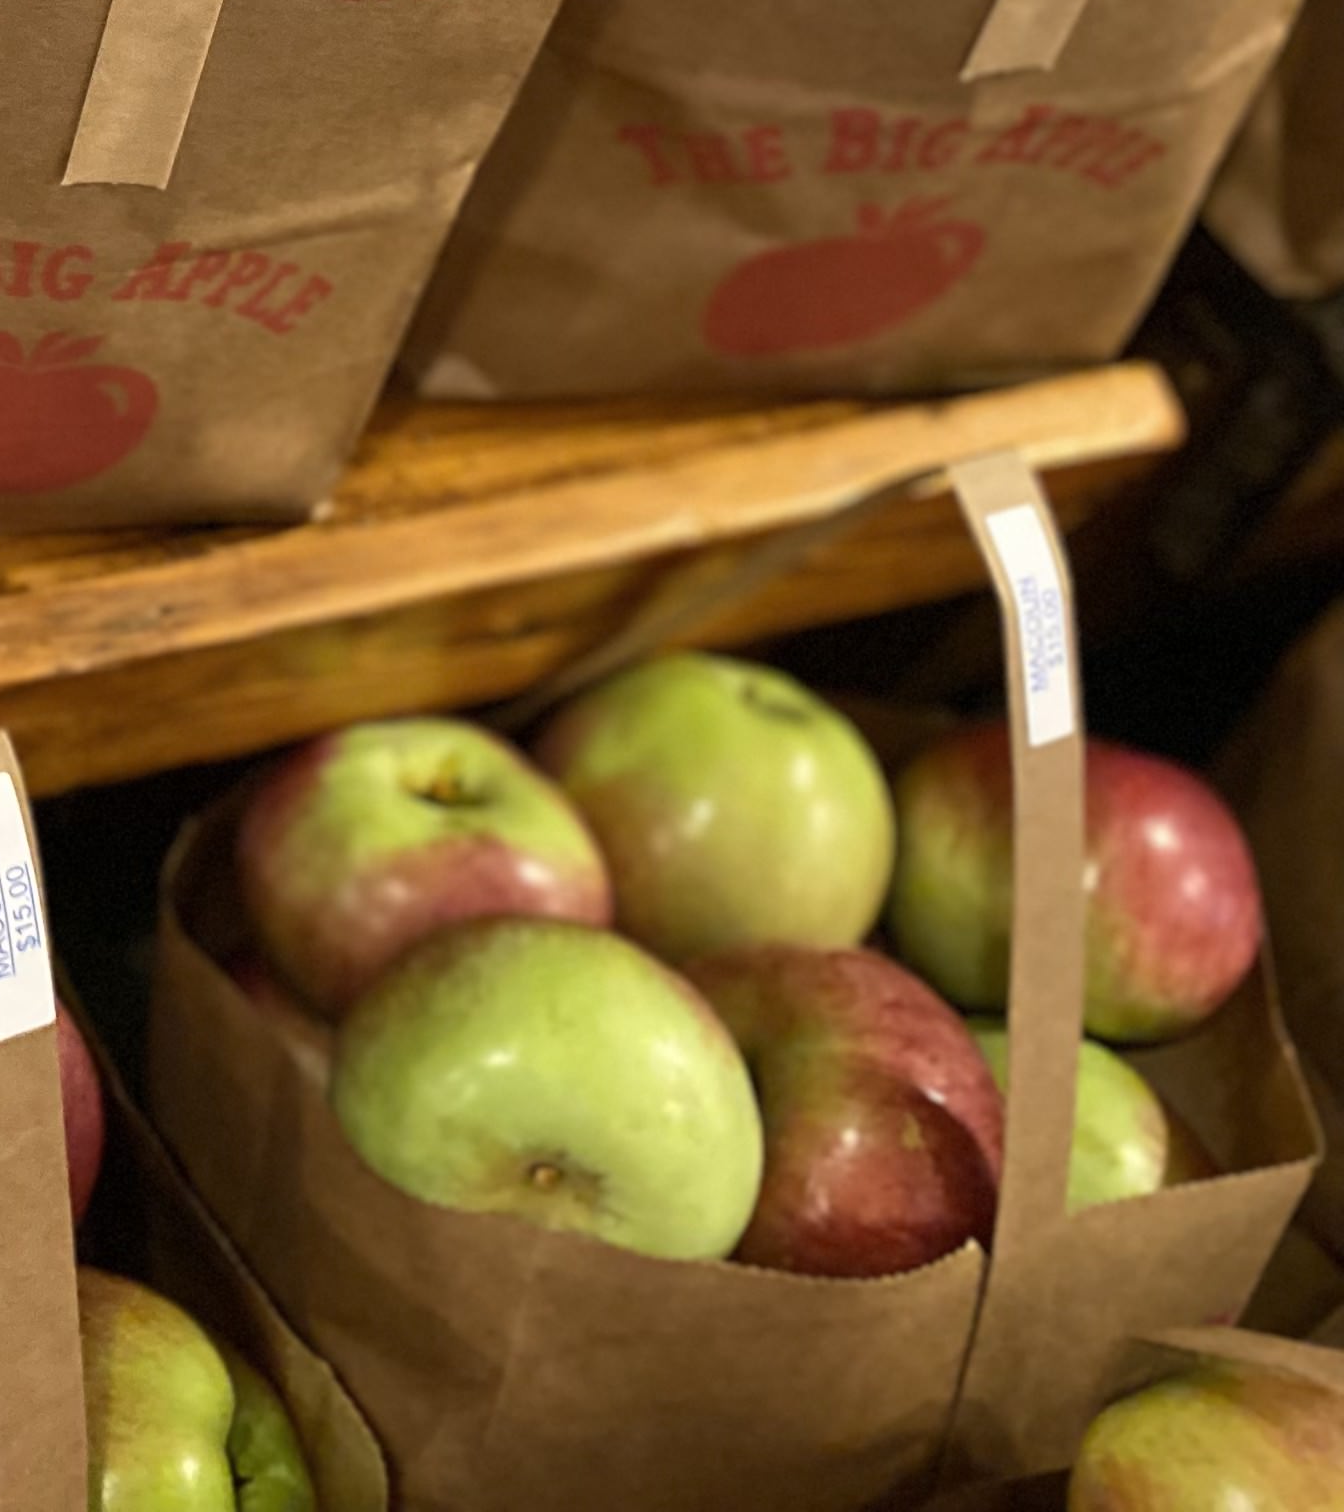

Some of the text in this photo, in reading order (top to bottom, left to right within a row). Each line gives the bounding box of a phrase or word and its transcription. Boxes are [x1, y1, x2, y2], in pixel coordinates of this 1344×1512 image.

[615, 123, 793, 187] THE
[822, 106, 970, 176] BIG
[111, 241, 334, 336] APPLE
[5, 862, 41, 953] $15.00
